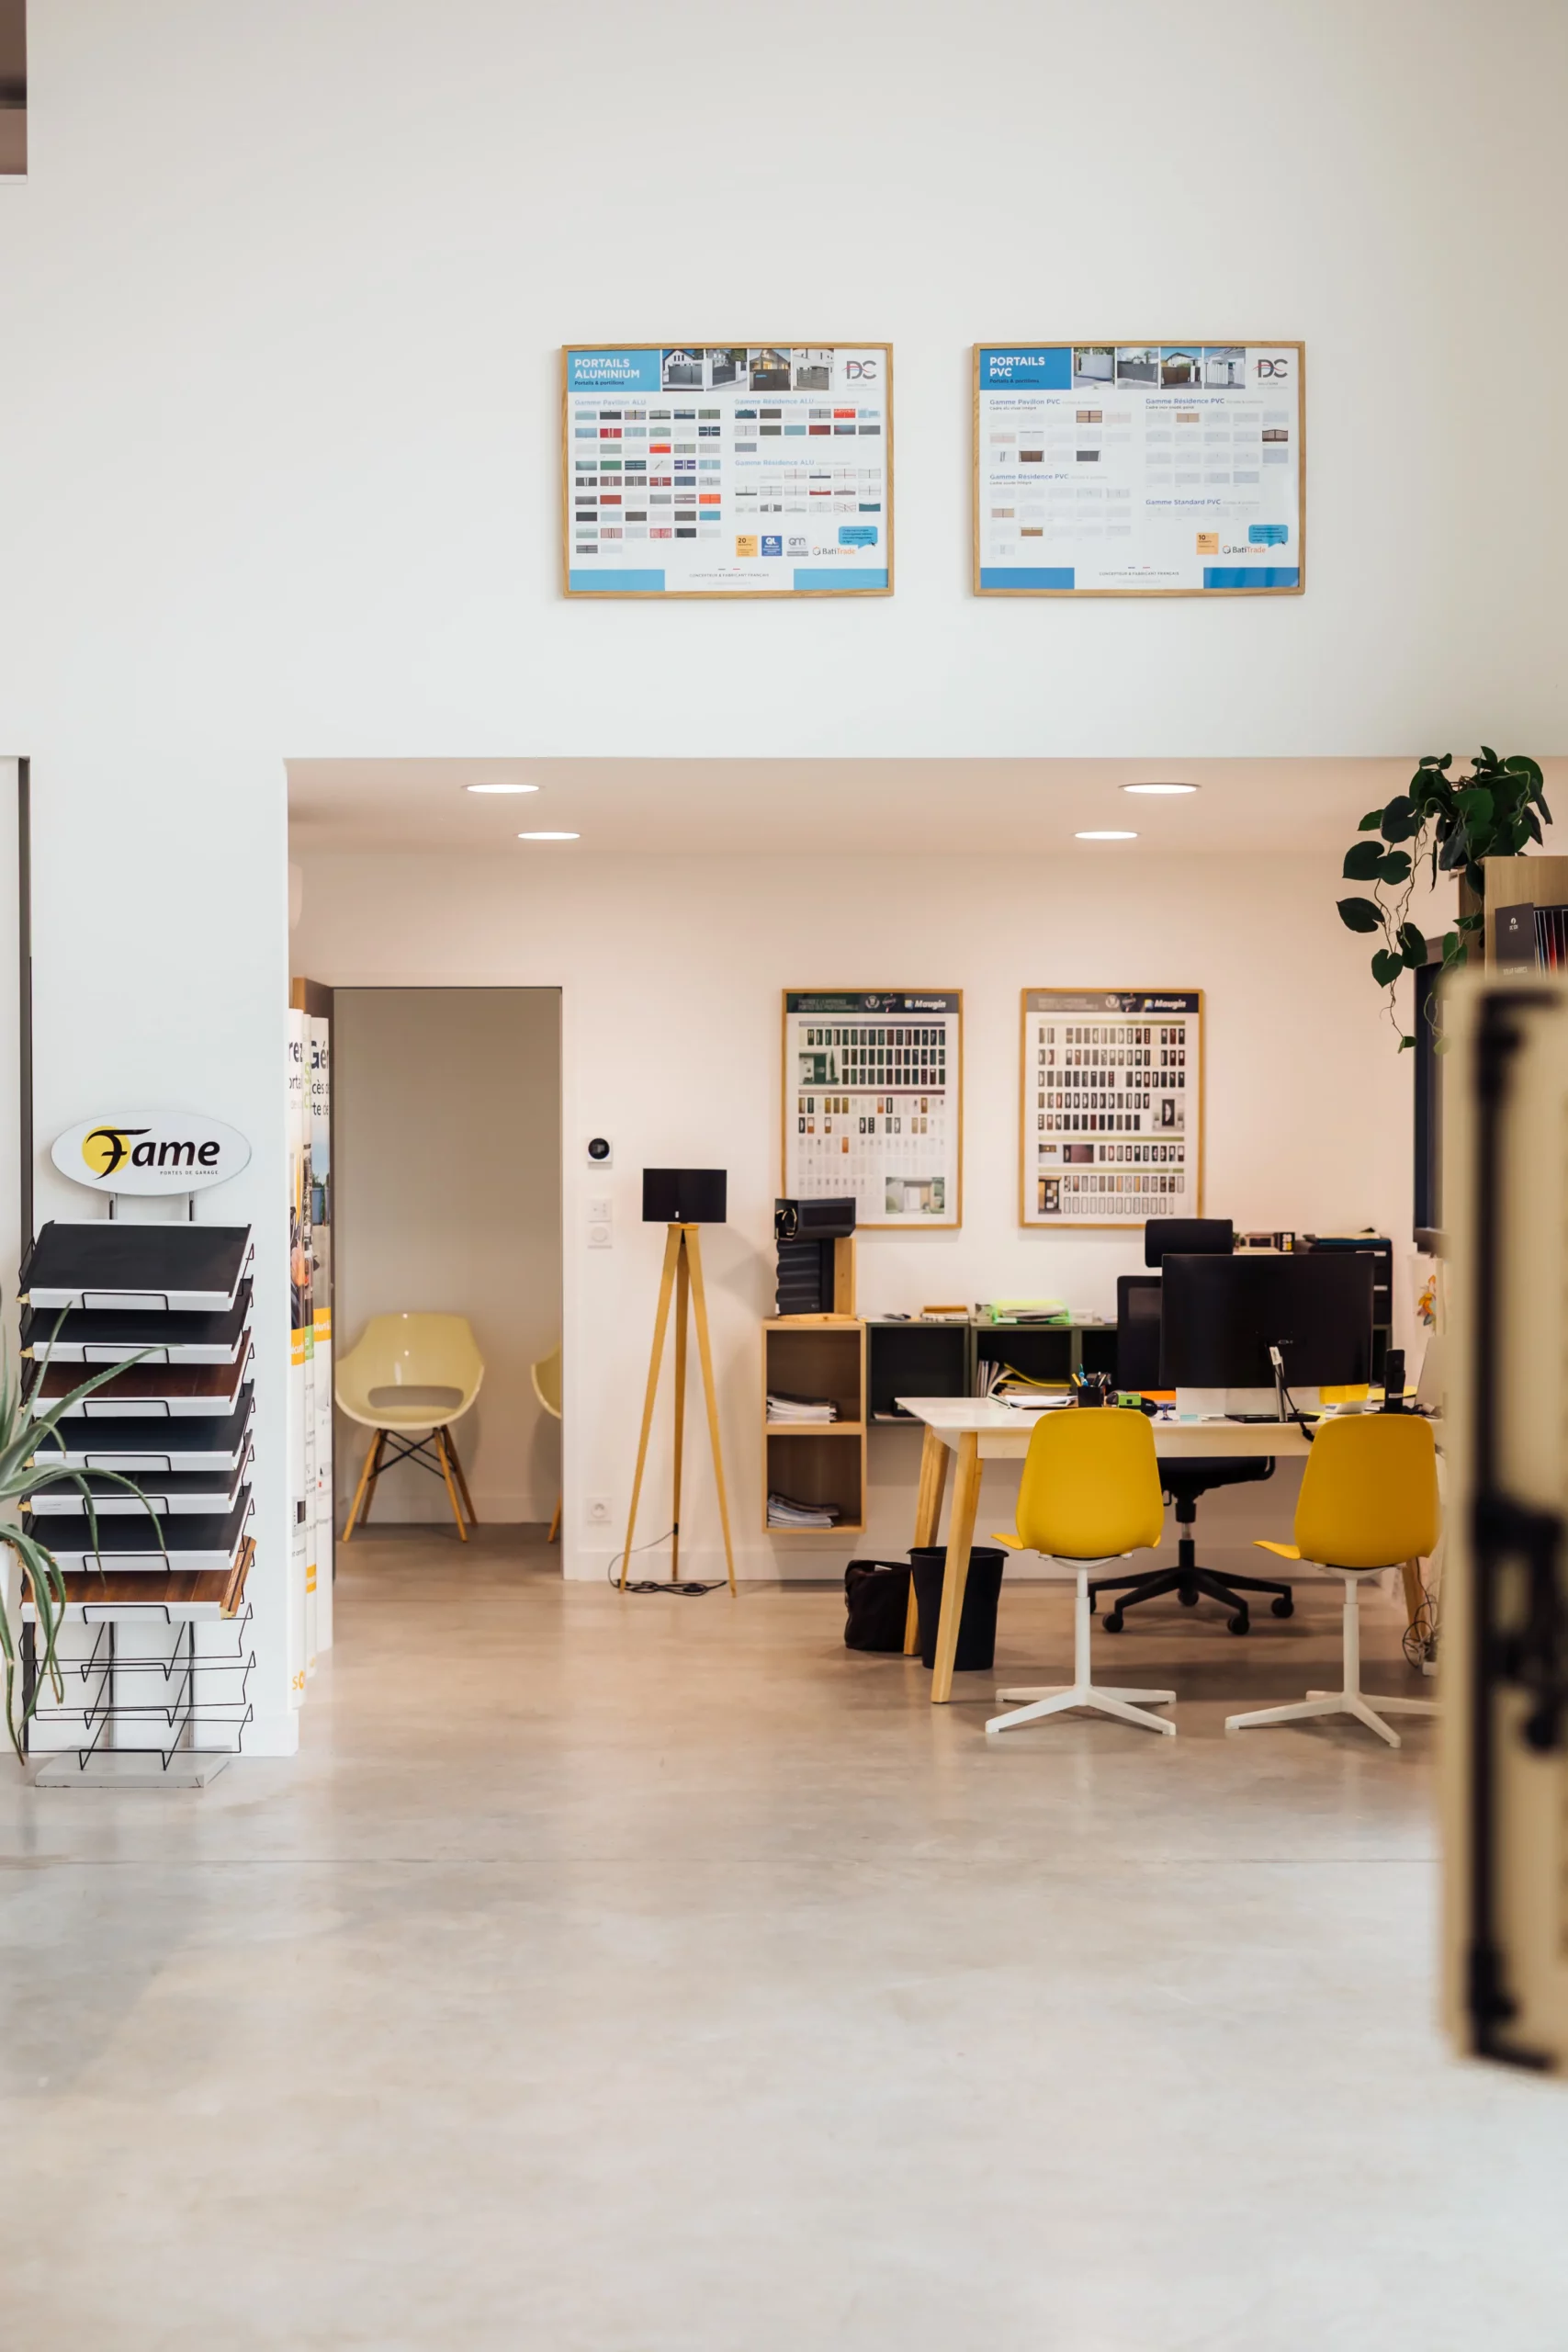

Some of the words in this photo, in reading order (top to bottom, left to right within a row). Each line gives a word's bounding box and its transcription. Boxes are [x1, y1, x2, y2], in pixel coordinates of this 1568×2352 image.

[575, 358, 630, 368] PORTAILS
[989, 356, 1045, 366] PORTAILS
[575, 369, 640, 379] ALUMINIUM
[989, 368, 1012, 377] PVC
[914, 1000, 947, 1009] Maugin
[1154, 1000, 1186, 1009] Maugin
[86, 1128, 220, 1180] Fame
